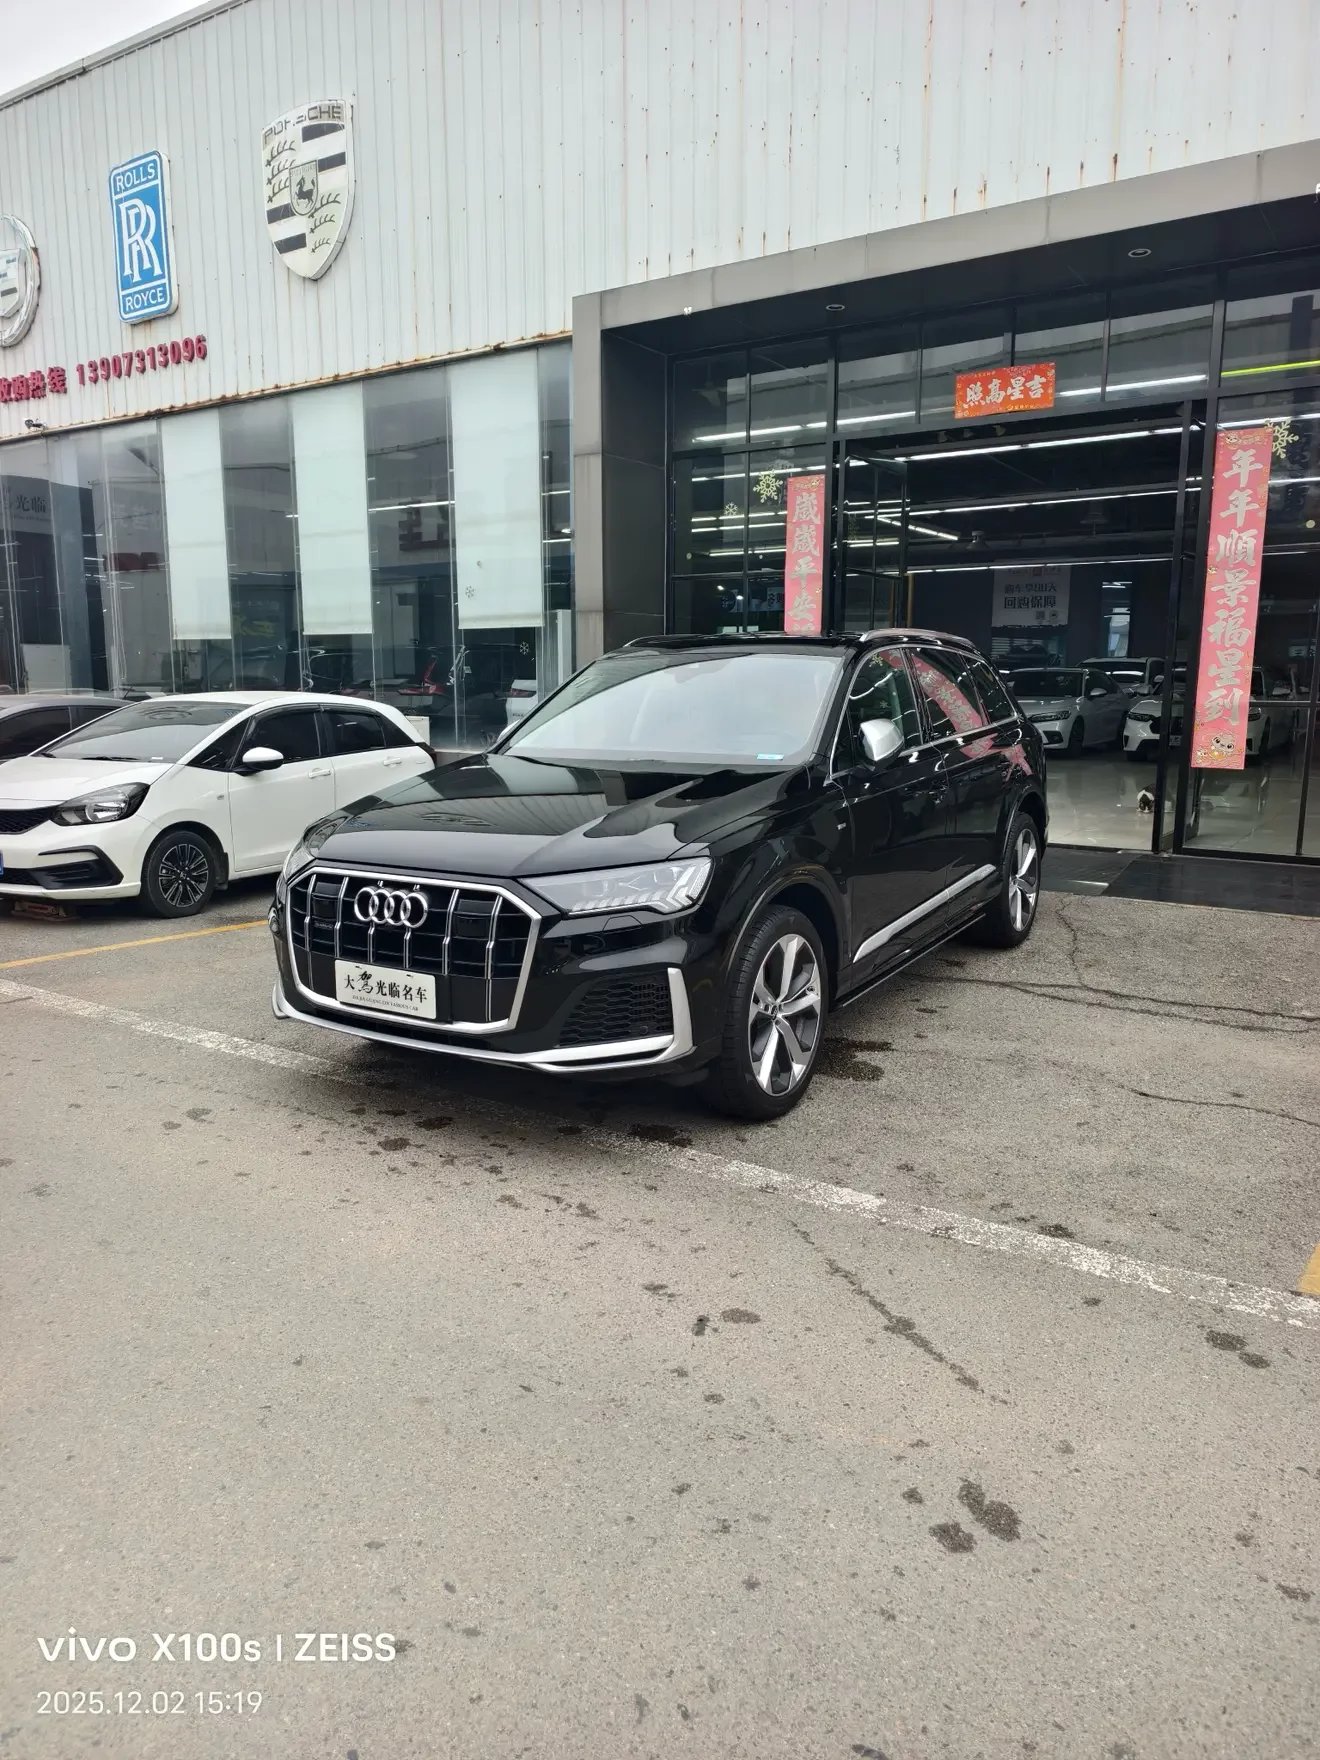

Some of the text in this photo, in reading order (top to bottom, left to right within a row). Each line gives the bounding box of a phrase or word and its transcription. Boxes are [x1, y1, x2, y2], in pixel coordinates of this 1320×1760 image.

[115, 162, 156, 192] ROLLS
[125, 287, 165, 312] ROYCE
[76, 334, 208, 386] 13907313096
[344, 970, 428, 1004] 大驾光临名车
